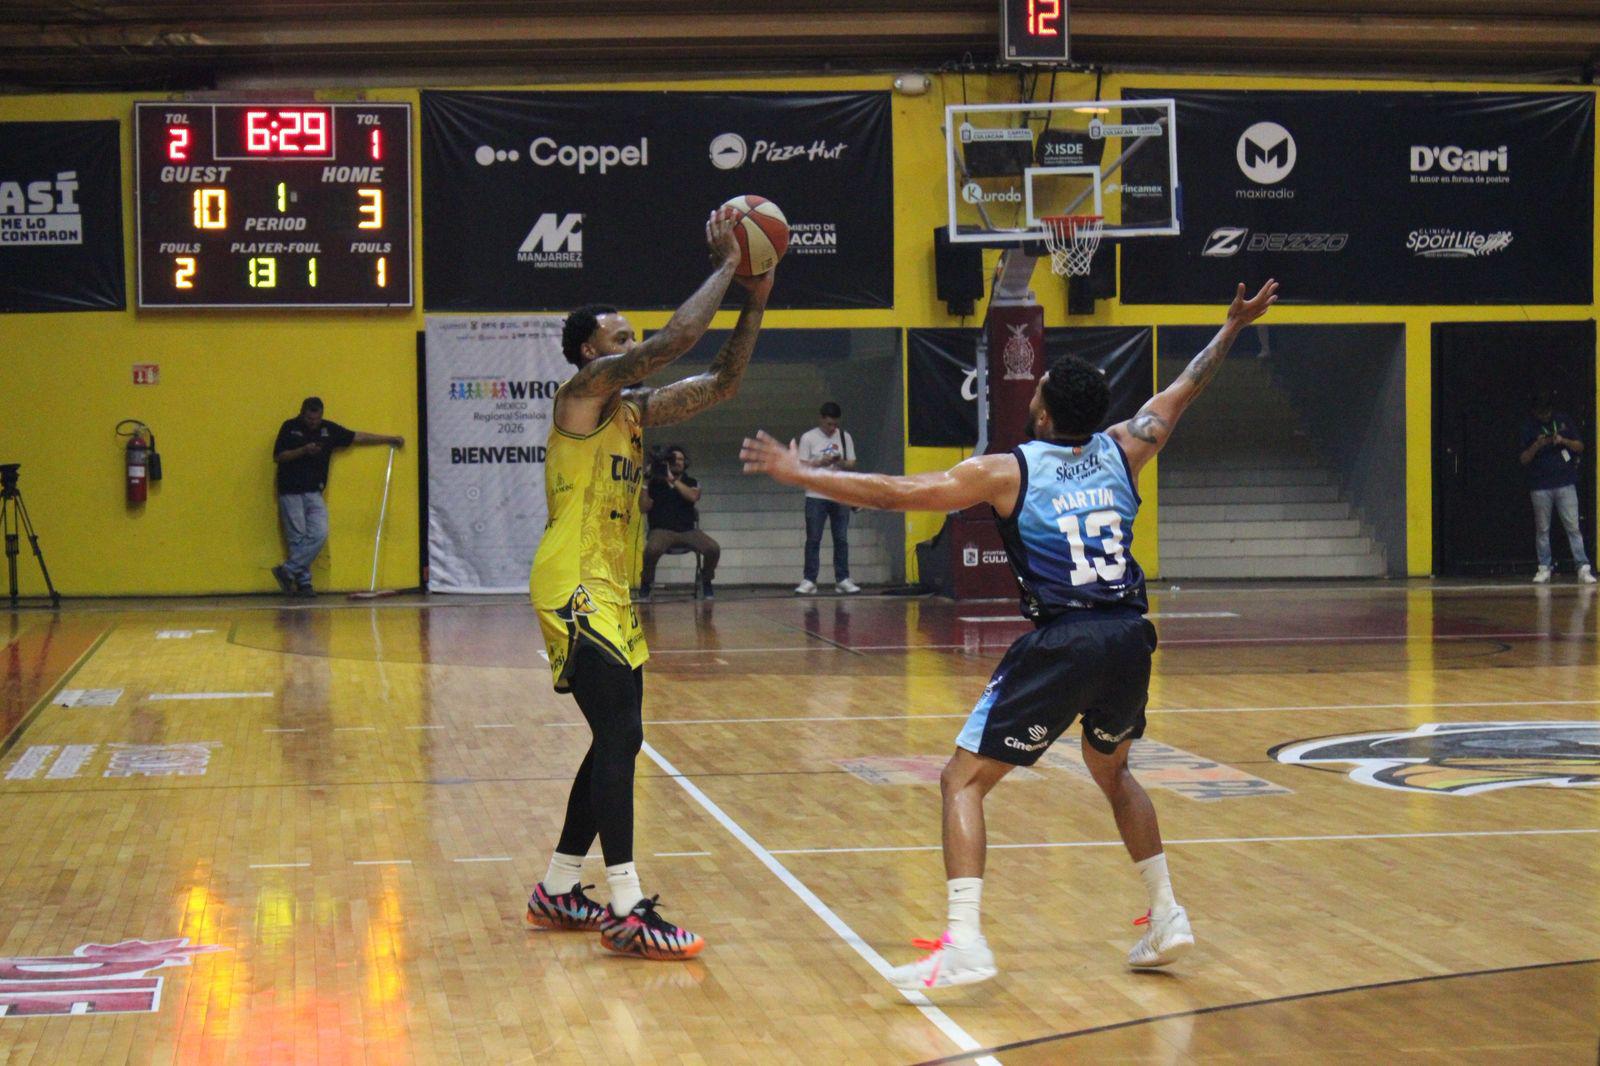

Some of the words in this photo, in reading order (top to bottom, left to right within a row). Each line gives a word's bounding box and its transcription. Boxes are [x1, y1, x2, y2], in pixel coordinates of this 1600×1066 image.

[1028, 0, 1060, 35] 12
[165, 113, 190, 125] TOL
[356, 114, 381, 125] TOL
[247, 111, 326, 151] 6:29
[169, 128, 188, 159] 2
[371, 129, 380, 160] 1
[751, 140, 805, 163] Pizza
[806, 140, 848, 161] Hut
[1056, 143, 1083, 155] ISDE
[529, 137, 648, 174] Coppel
[1410, 145, 1508, 172] D'Gari
[160, 166, 231, 183] GUEST
[321, 166, 384, 183] HOME
[1410, 175, 1418, 183] El
[1451, 175, 1474, 183] forma
[1475, 175, 1485, 183] de
[1486, 175, 1510, 184] postre
[0, 171, 80, 214] ASÍ
[1120, 184, 1162, 193] Fincamex
[1235, 188, 1295, 199] maxiradio
[277, 182, 287, 213] 1
[193, 189, 227, 229] 10
[357, 189, 383, 229] 3
[1, 218, 22, 229] ME
[26, 218, 46, 229] LO
[244, 217, 307, 231] PERIOD
[823, 223, 836, 231] DE
[1, 229, 78, 241] CONTARON
[789, 231, 837, 245] ACÁN
[1247, 233, 1349, 251] DEZZO
[1406, 230, 1485, 252] SportLife
[159, 242, 201, 253] FOULS
[230, 242, 321, 253] PLAYER-FOUL
[350, 242, 392, 253] FOULS
[517, 252, 583, 262] MANJARREZ
[175, 257, 196, 288] 2
[248, 257, 277, 288] 13
[308, 257, 317, 288] 1
[376, 257, 387, 288] 1
[508, 380, 560, 399] WRO
[473, 412, 512, 423] Regional
[514, 411, 547, 421] Sinaloa
[498, 423, 525, 434] 2026
[1057, 510, 1128, 586] 13
